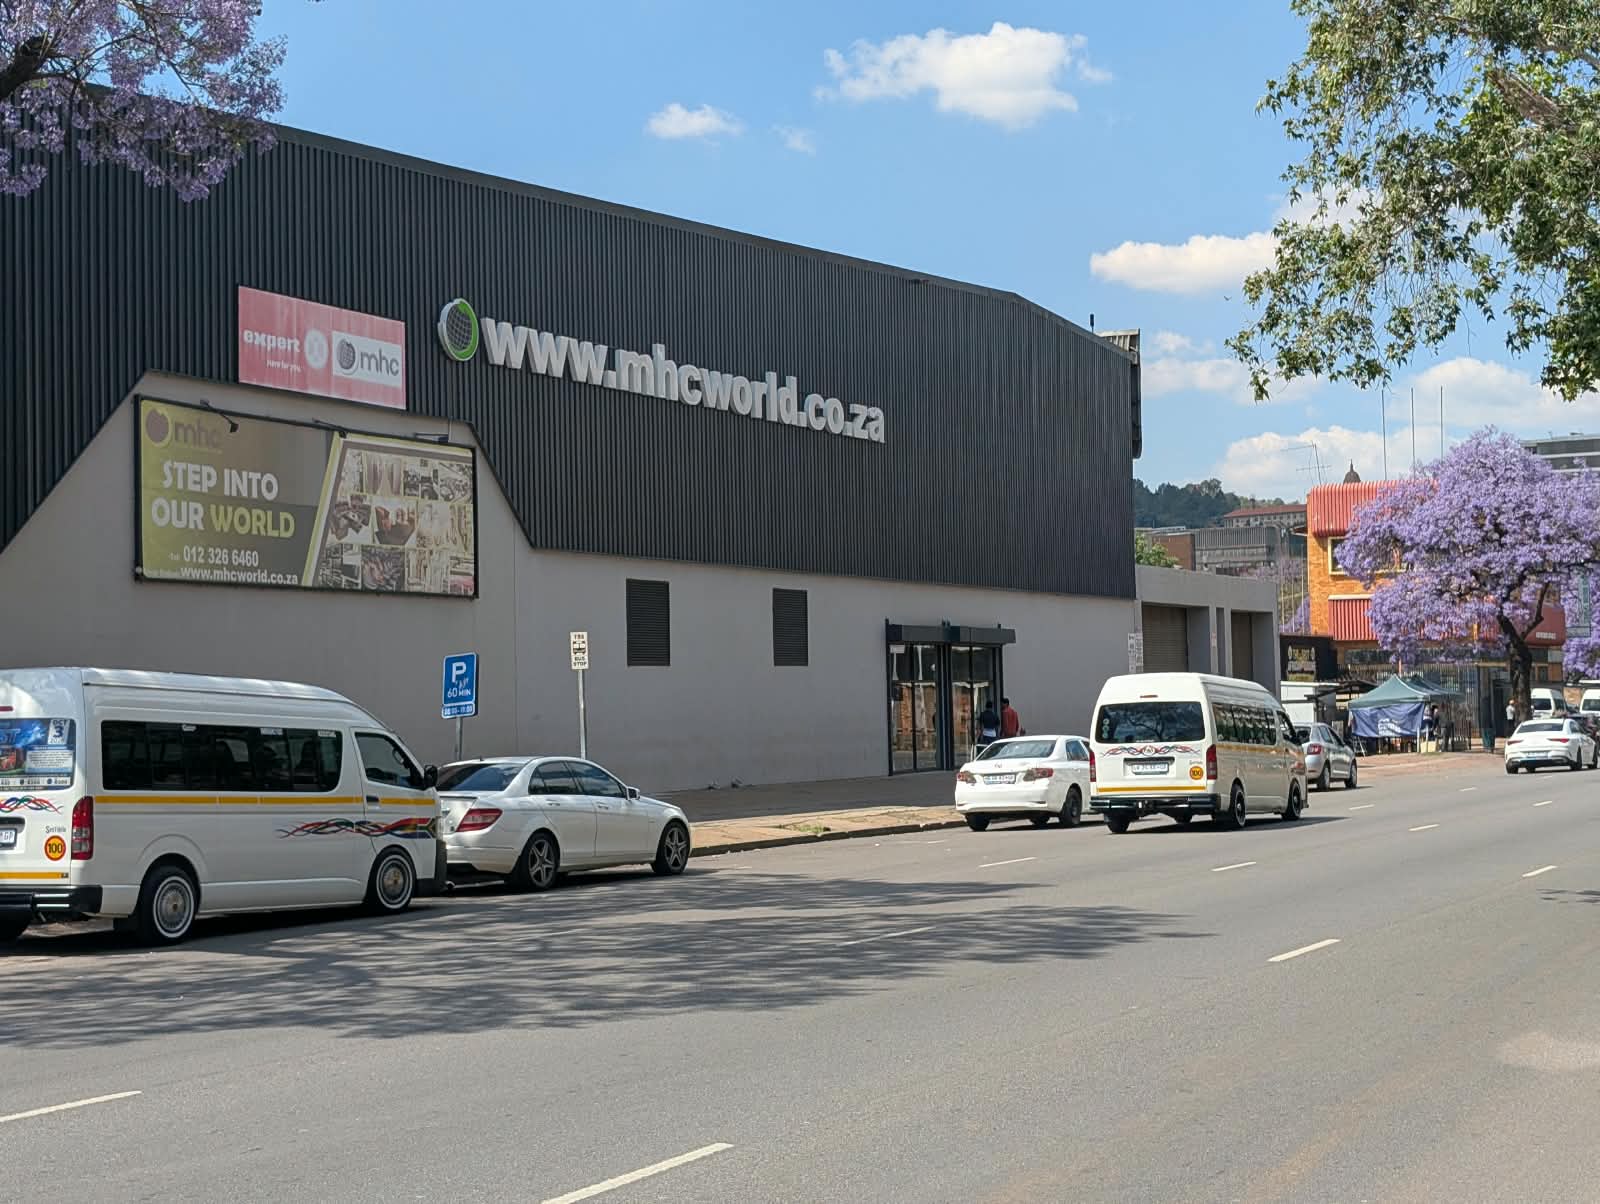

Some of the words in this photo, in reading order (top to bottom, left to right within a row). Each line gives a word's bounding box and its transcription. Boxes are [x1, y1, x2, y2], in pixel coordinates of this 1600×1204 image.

[243, 329, 300, 353] expert
[360, 348, 400, 377] mhc
[480, 317, 886, 444] www.mhcworld.co.za
[163, 461, 218, 493] STEP
[223, 468, 279, 500] INTO
[152, 498, 204, 530] OUR
[209, 503, 295, 538] WORLD
[183, 545, 205, 563] 012
[208, 548, 229, 564] 326
[231, 550, 259, 567] 6460
[180, 567, 299, 585] www.mhcworld.co.za
[451, 661, 467, 683] P
[447, 687, 457, 698] 60
[52, 725, 65, 738] 3
[47, 843, 63, 854] 100
